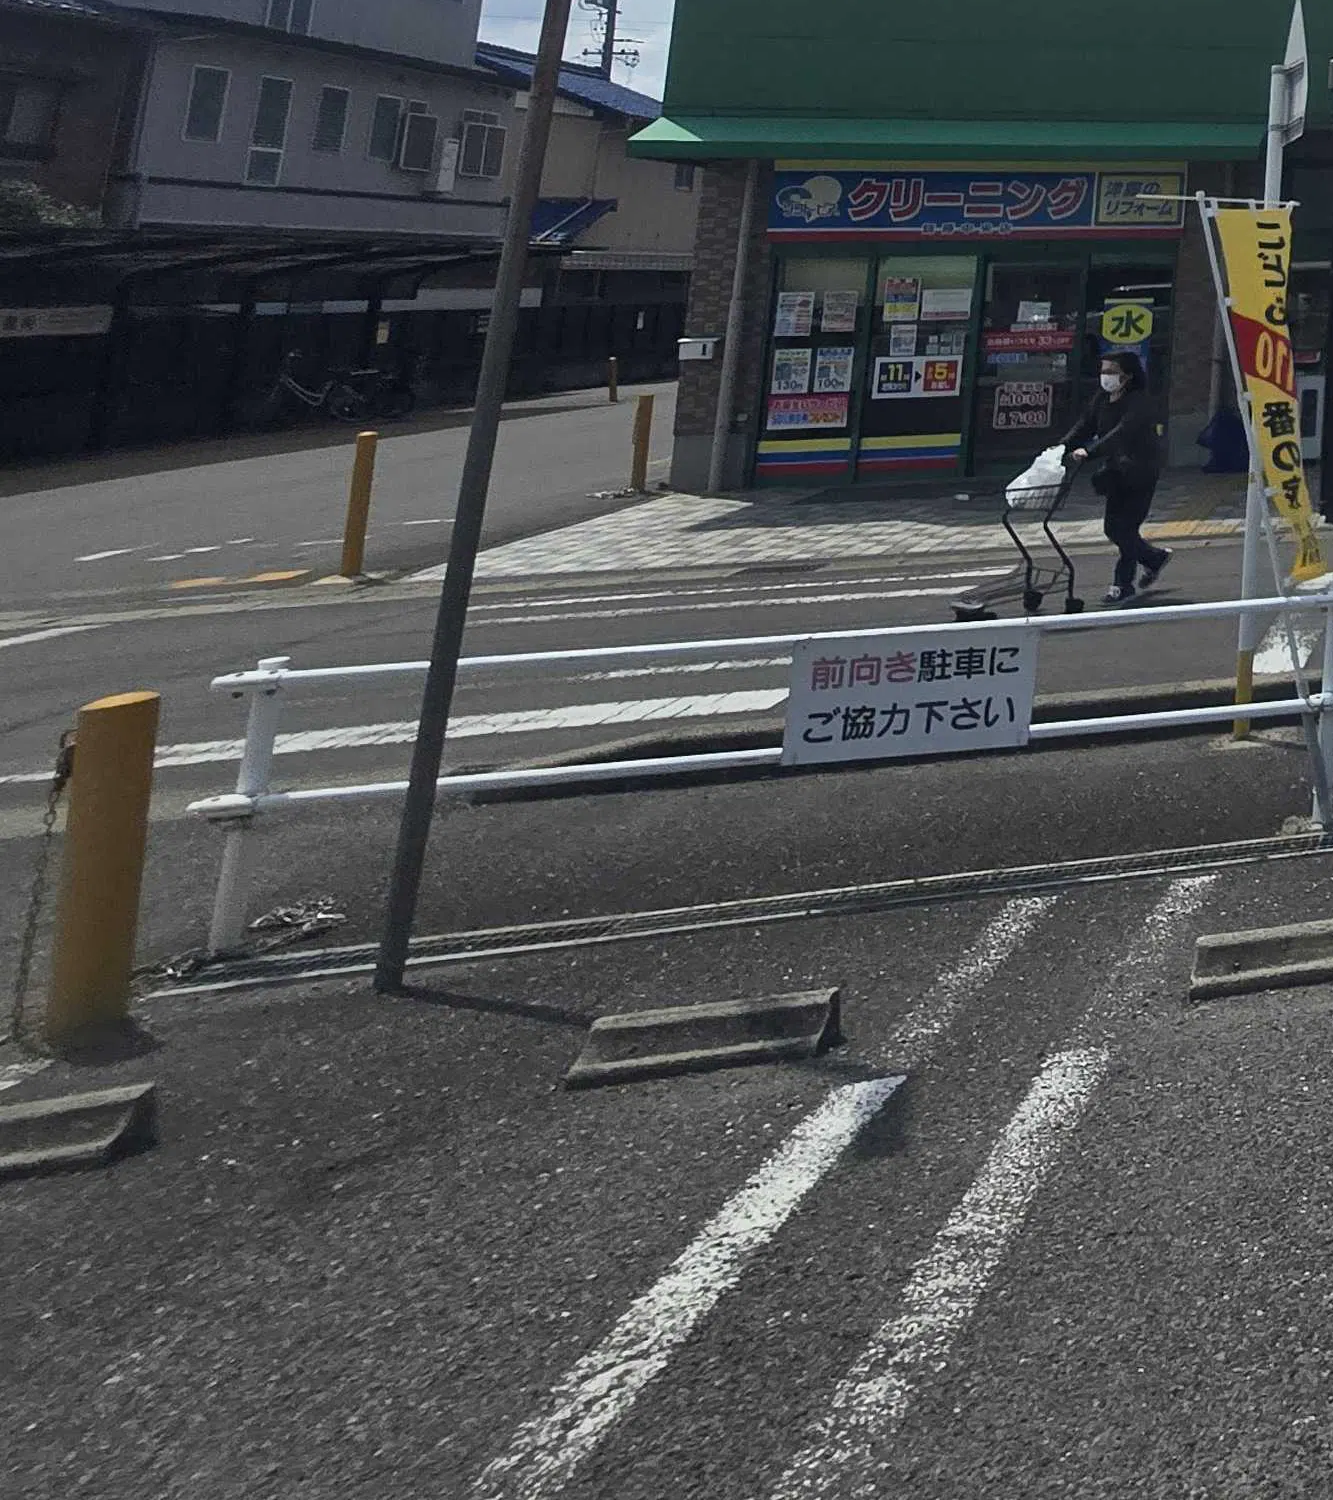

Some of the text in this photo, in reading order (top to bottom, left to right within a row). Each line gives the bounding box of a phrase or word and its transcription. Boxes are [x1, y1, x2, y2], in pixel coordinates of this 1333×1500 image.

[847, 177, 1088, 222] クリーニング
[1105, 200, 1173, 216] リフォーム
[1111, 310, 1145, 337] 水
[811, 647, 1020, 690] 前向き駐車に
[803, 697, 1015, 743] ご協力下さい
